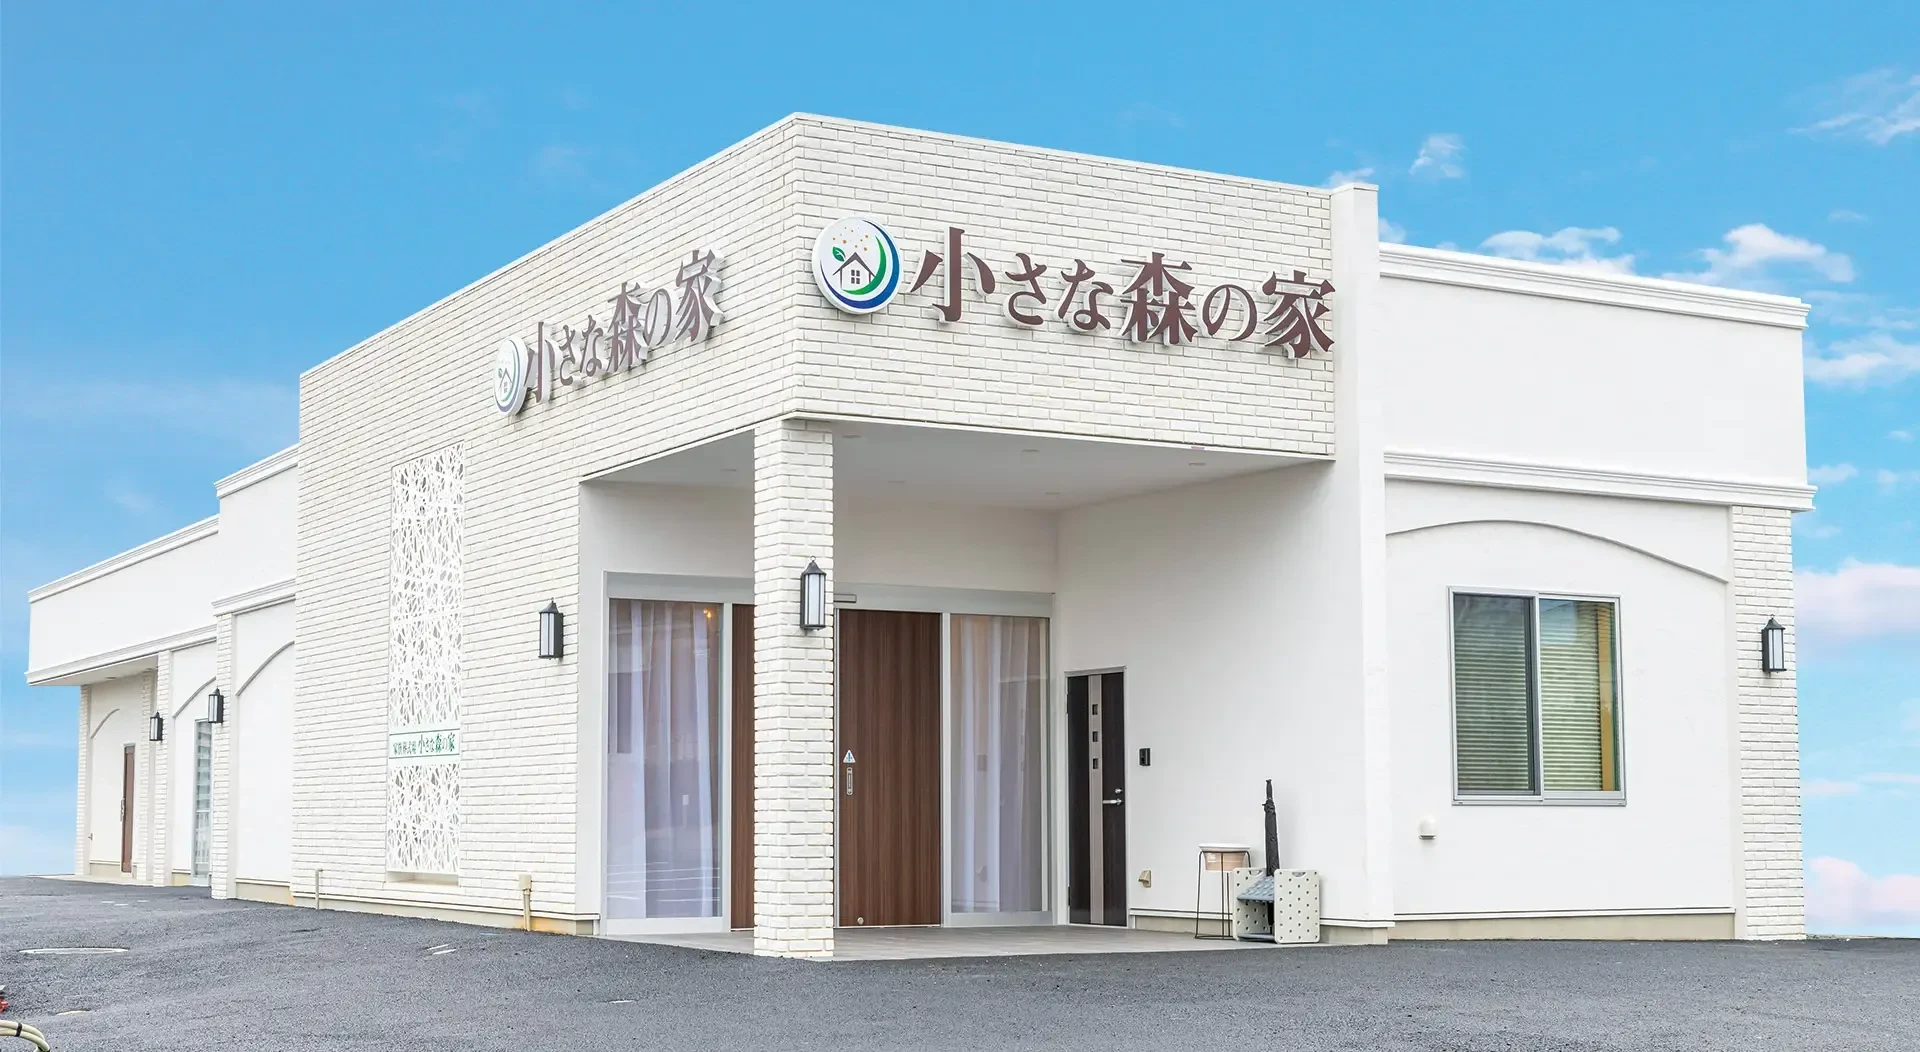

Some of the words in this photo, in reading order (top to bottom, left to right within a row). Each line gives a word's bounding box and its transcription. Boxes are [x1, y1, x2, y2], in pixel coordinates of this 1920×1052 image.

[524, 249, 722, 402] 小さな森の家
[908, 226, 1335, 358] 小さな森の家
[418, 732, 456, 755] 小さな森の家
